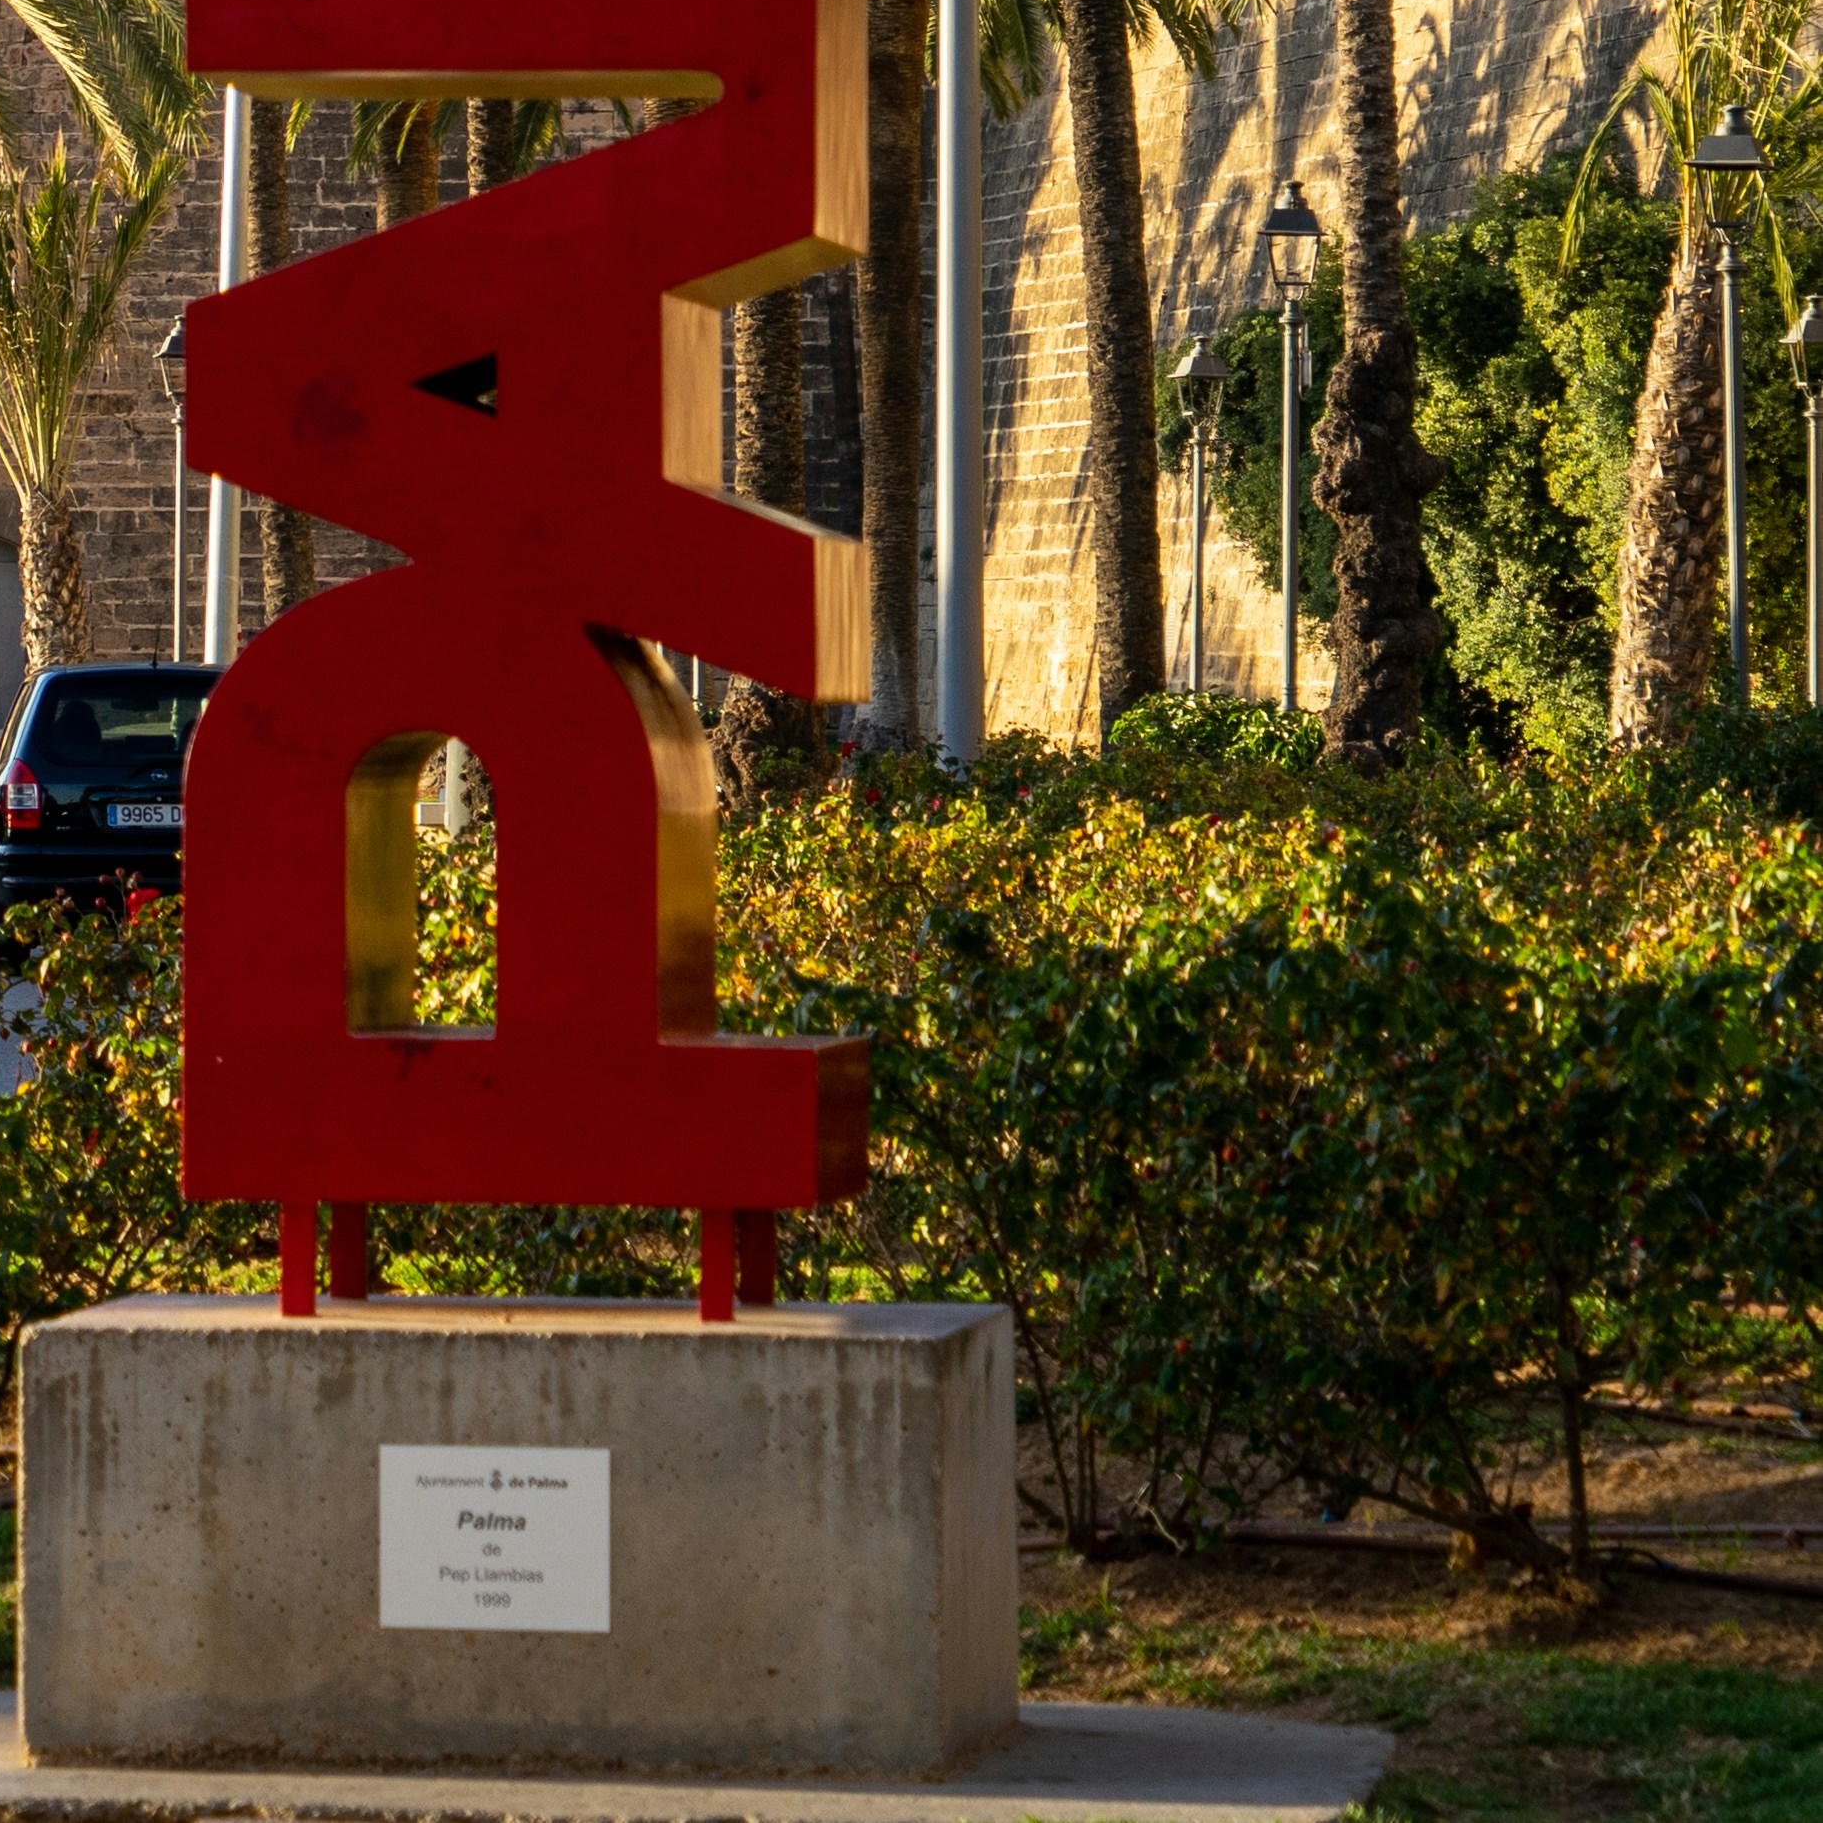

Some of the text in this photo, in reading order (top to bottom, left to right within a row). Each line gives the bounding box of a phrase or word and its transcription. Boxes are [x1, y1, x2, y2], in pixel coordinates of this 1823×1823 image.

[121, 806, 186, 823] 9965 D
[416, 1475, 568, 1489] Ajuntament de Palma
[458, 1510, 527, 1531] Palma
[482, 1543, 502, 1557] de
[439, 1566, 471, 1583] Pep
[473, 1592, 512, 1608] 1999
